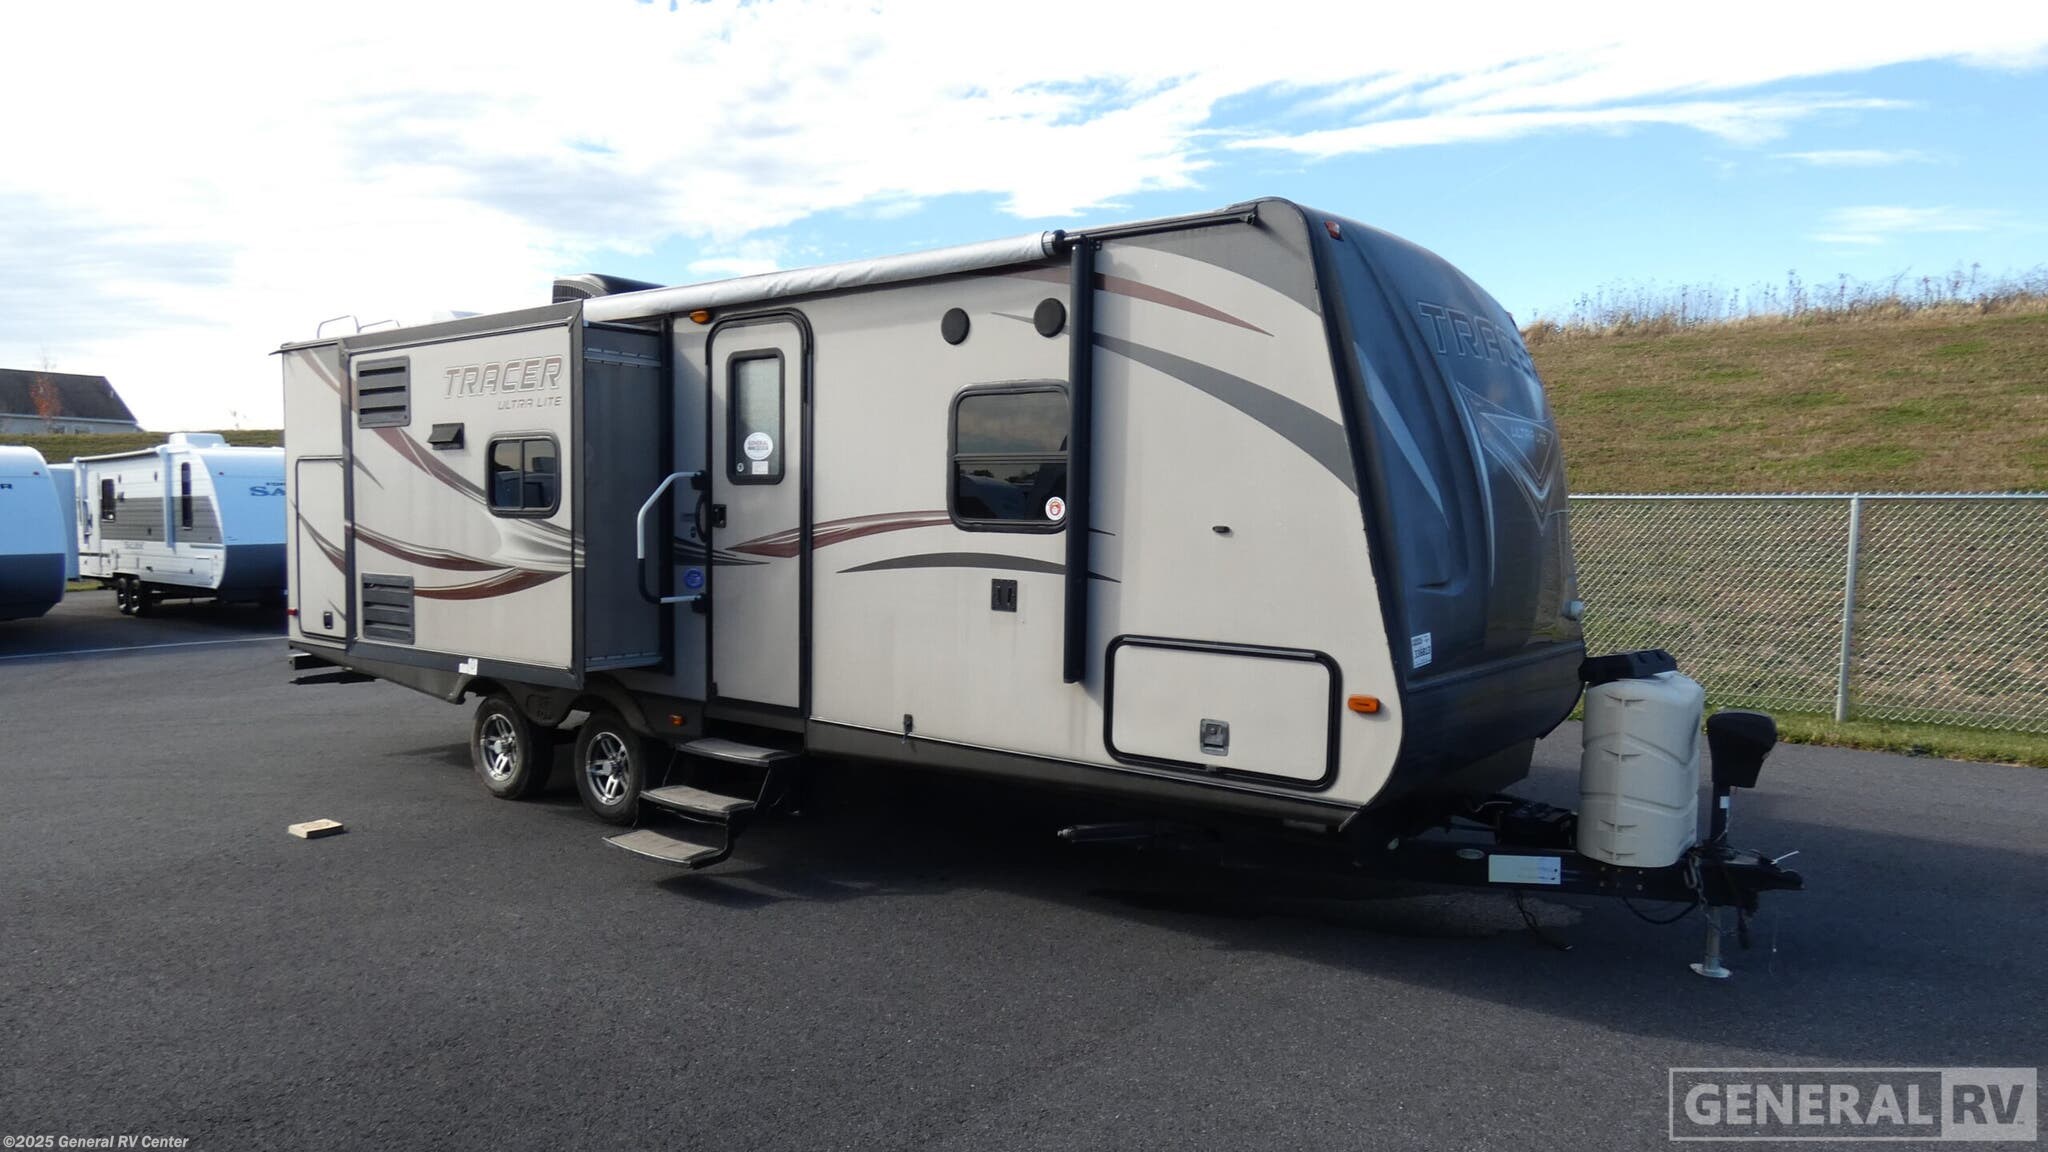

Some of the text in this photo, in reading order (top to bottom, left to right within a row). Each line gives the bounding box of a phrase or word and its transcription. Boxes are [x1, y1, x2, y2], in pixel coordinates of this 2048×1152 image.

[1417, 301, 1538, 379] TRACE
[443, 354, 563, 399] TRACER
[498, 396, 562, 410] ULTRA LITE
